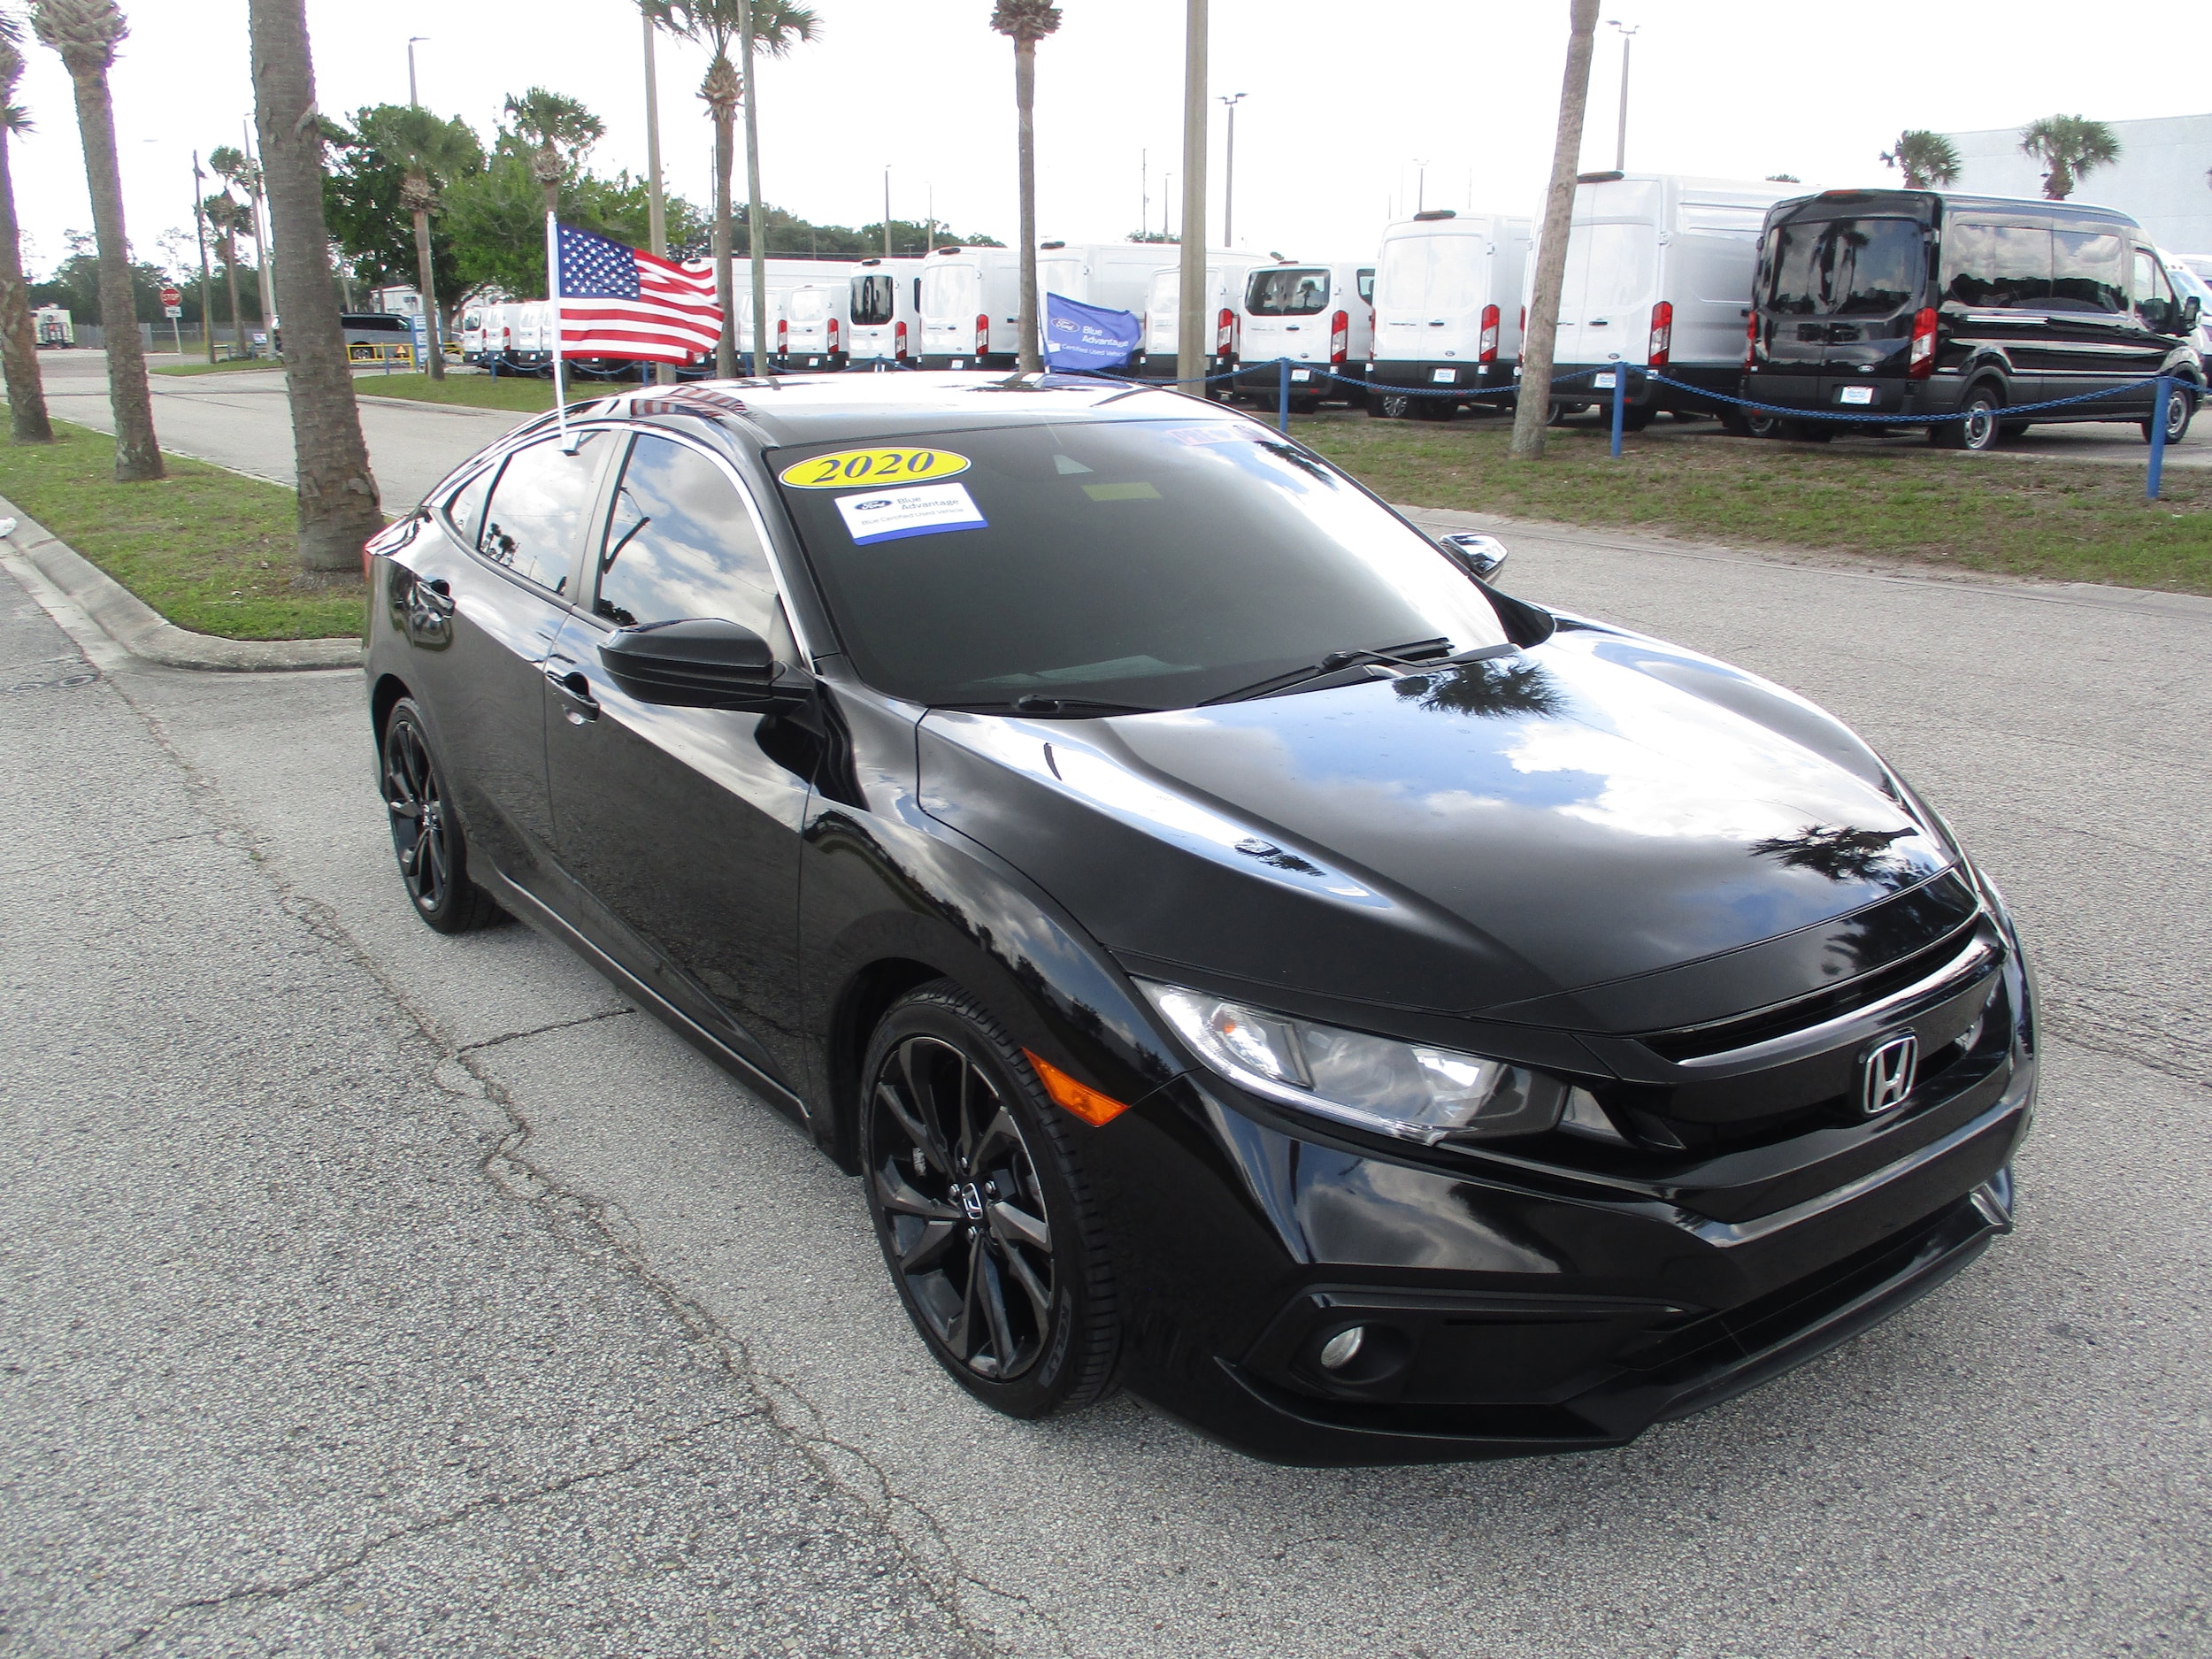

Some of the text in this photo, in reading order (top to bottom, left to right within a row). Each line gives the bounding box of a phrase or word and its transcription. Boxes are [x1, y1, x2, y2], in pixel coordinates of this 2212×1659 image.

[1055, 319, 1076, 331] Ford
[1082, 326, 1102, 335] Blue
[1081, 335, 1128, 348] Advantage
[1063, 343, 1088, 353] Certified
[810, 452, 934, 483] 2020
[859, 500, 887, 510] Ford
[902, 499, 959, 510] Advantage
[880, 513, 915, 522] Certified
